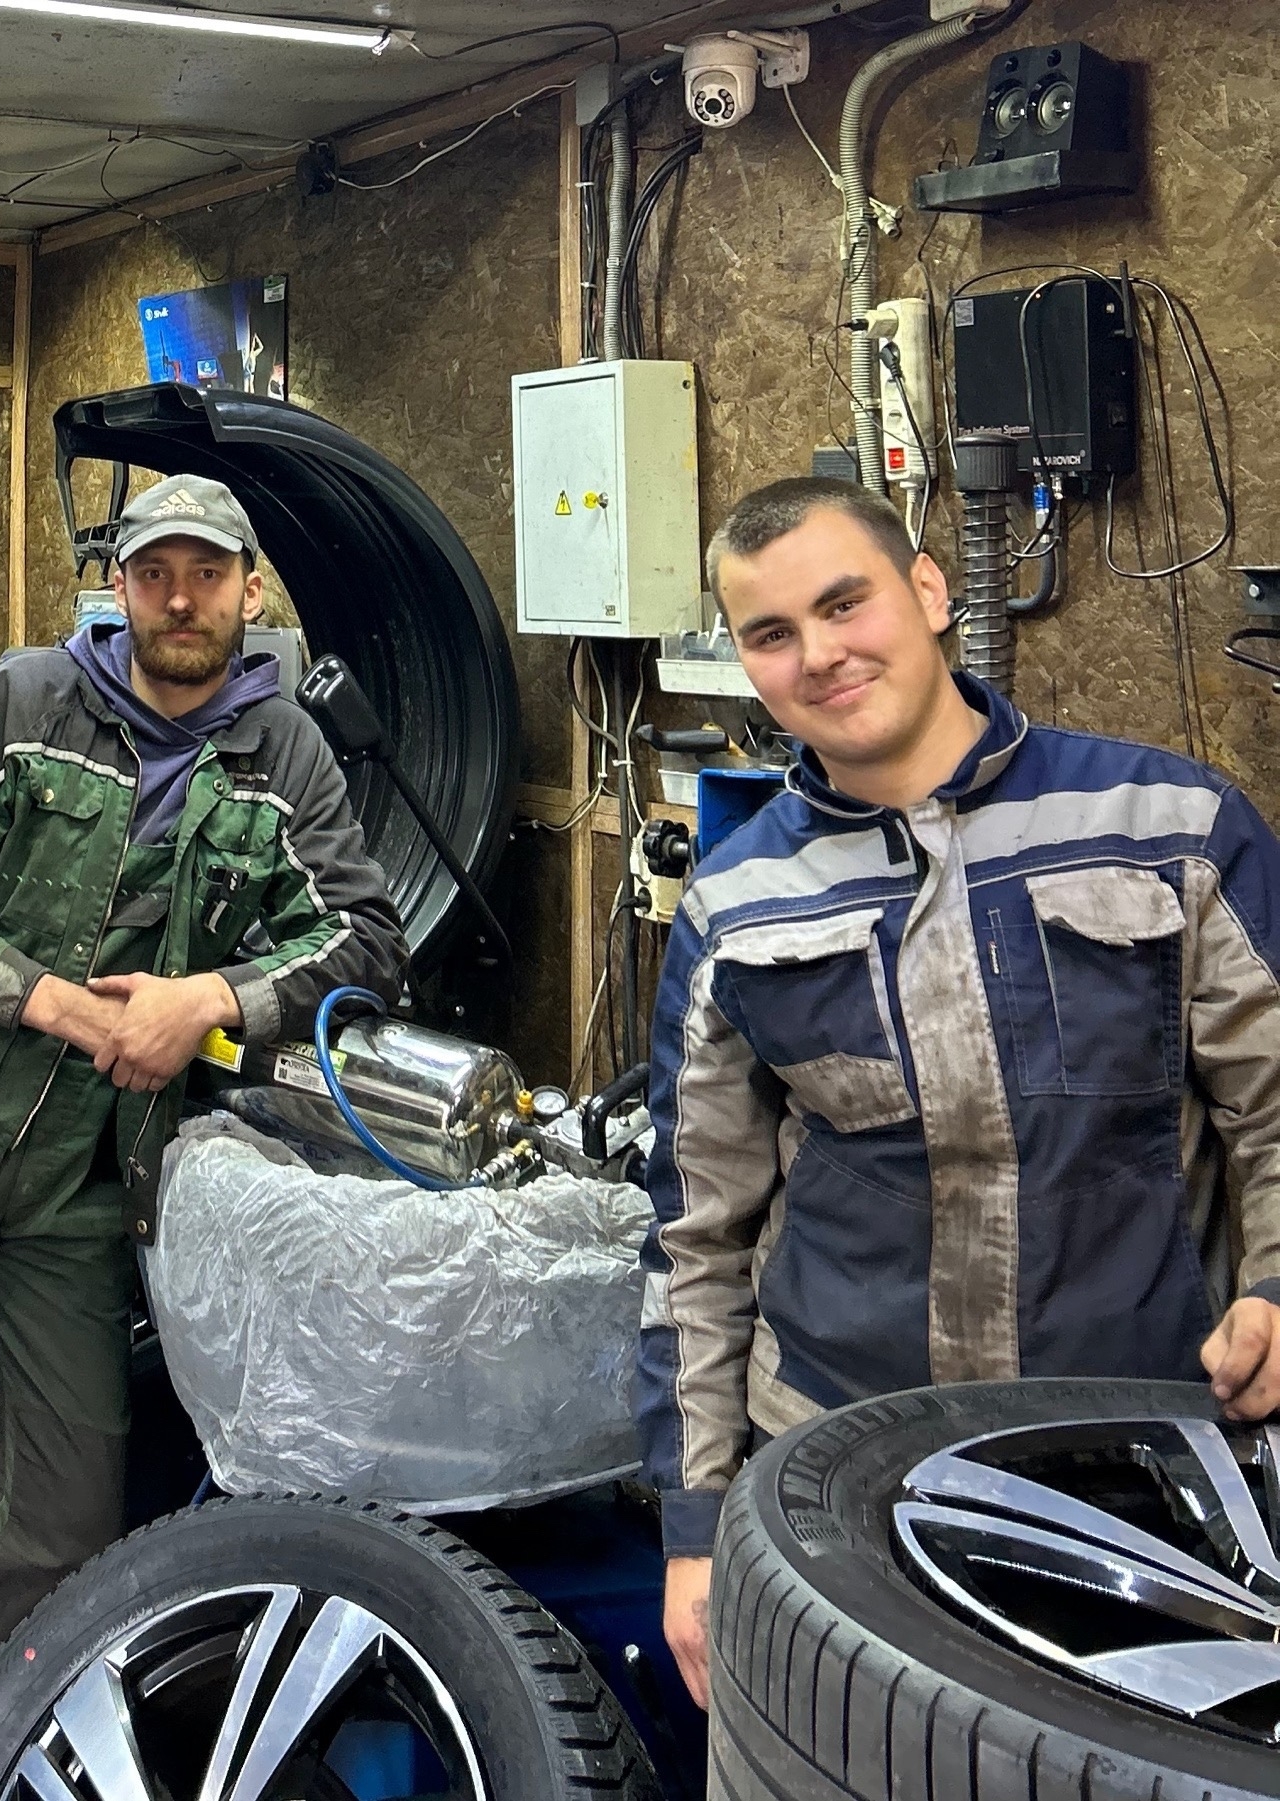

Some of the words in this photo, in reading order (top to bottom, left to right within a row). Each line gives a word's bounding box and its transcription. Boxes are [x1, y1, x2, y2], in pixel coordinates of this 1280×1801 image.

[1003, 424, 1030, 438] System
[1032, 455, 1081, 466] NAROVICH
[150, 502, 206, 517] adidas
[782, 1388, 930, 1504] MICHELIN
